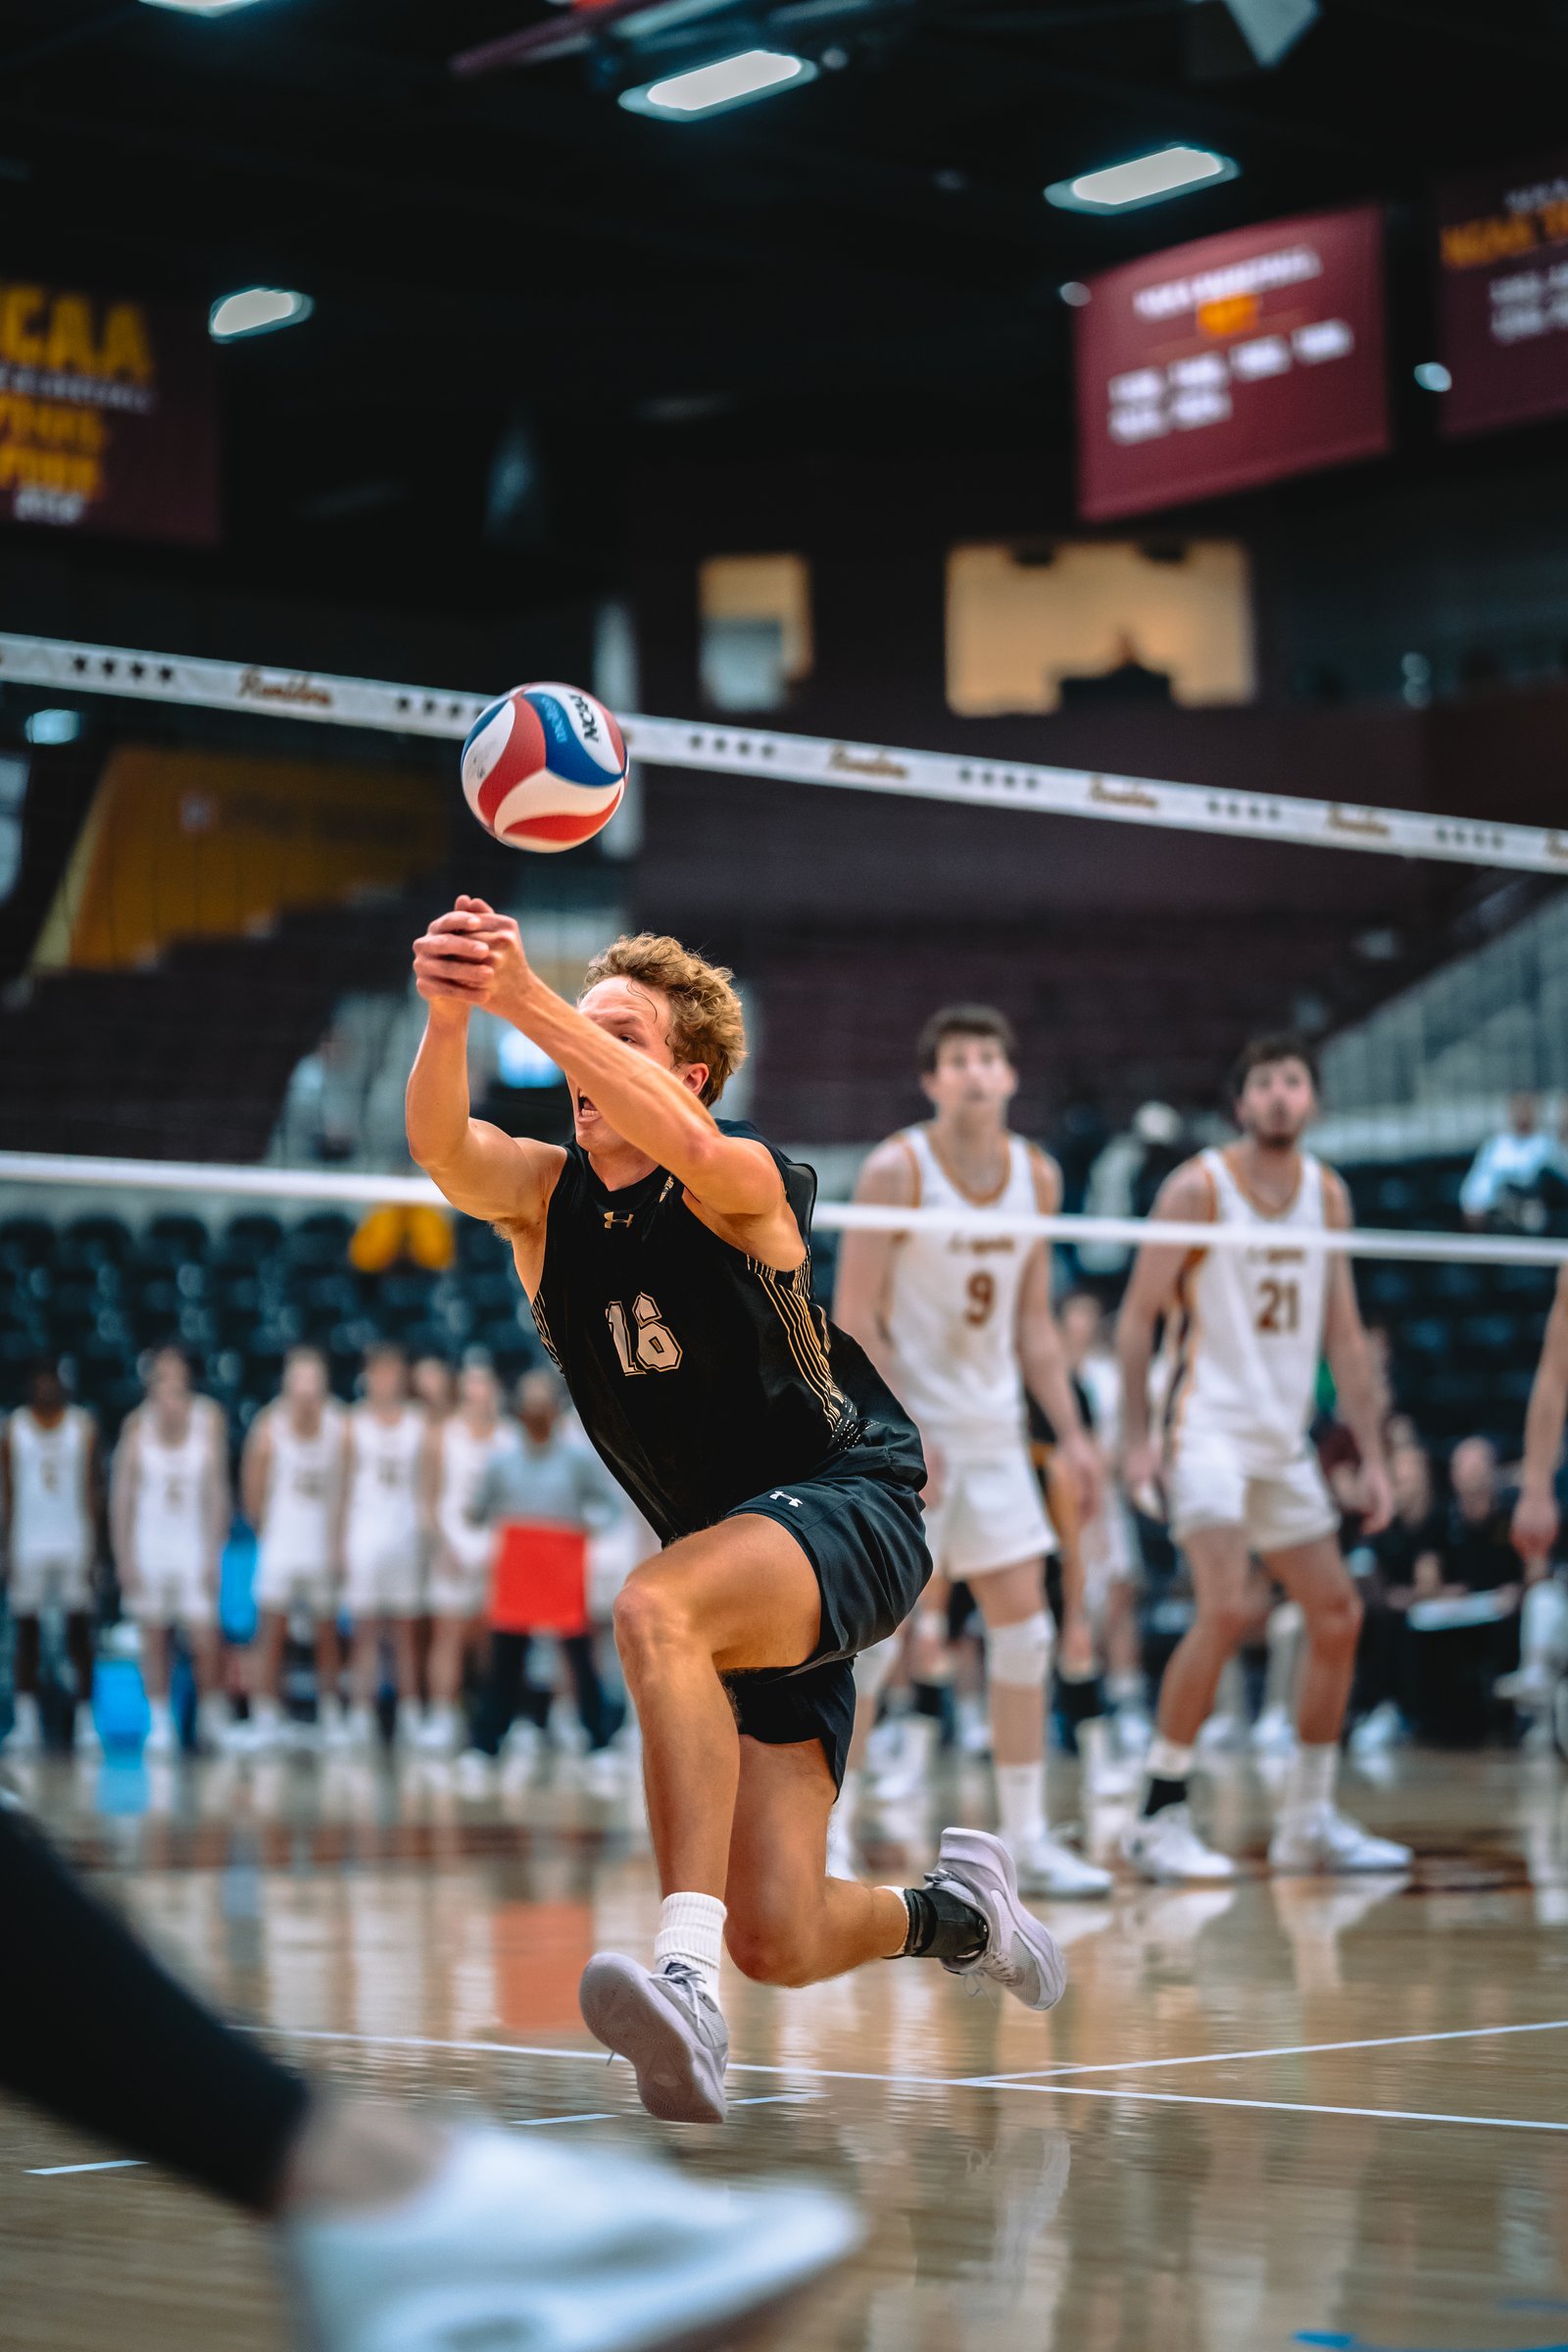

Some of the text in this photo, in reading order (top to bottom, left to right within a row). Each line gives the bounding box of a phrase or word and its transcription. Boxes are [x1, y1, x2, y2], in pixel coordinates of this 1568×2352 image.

[964, 1271, 996, 1328] 9
[1257, 1278, 1300, 1334] 21
[606, 1292, 684, 1376] 16
